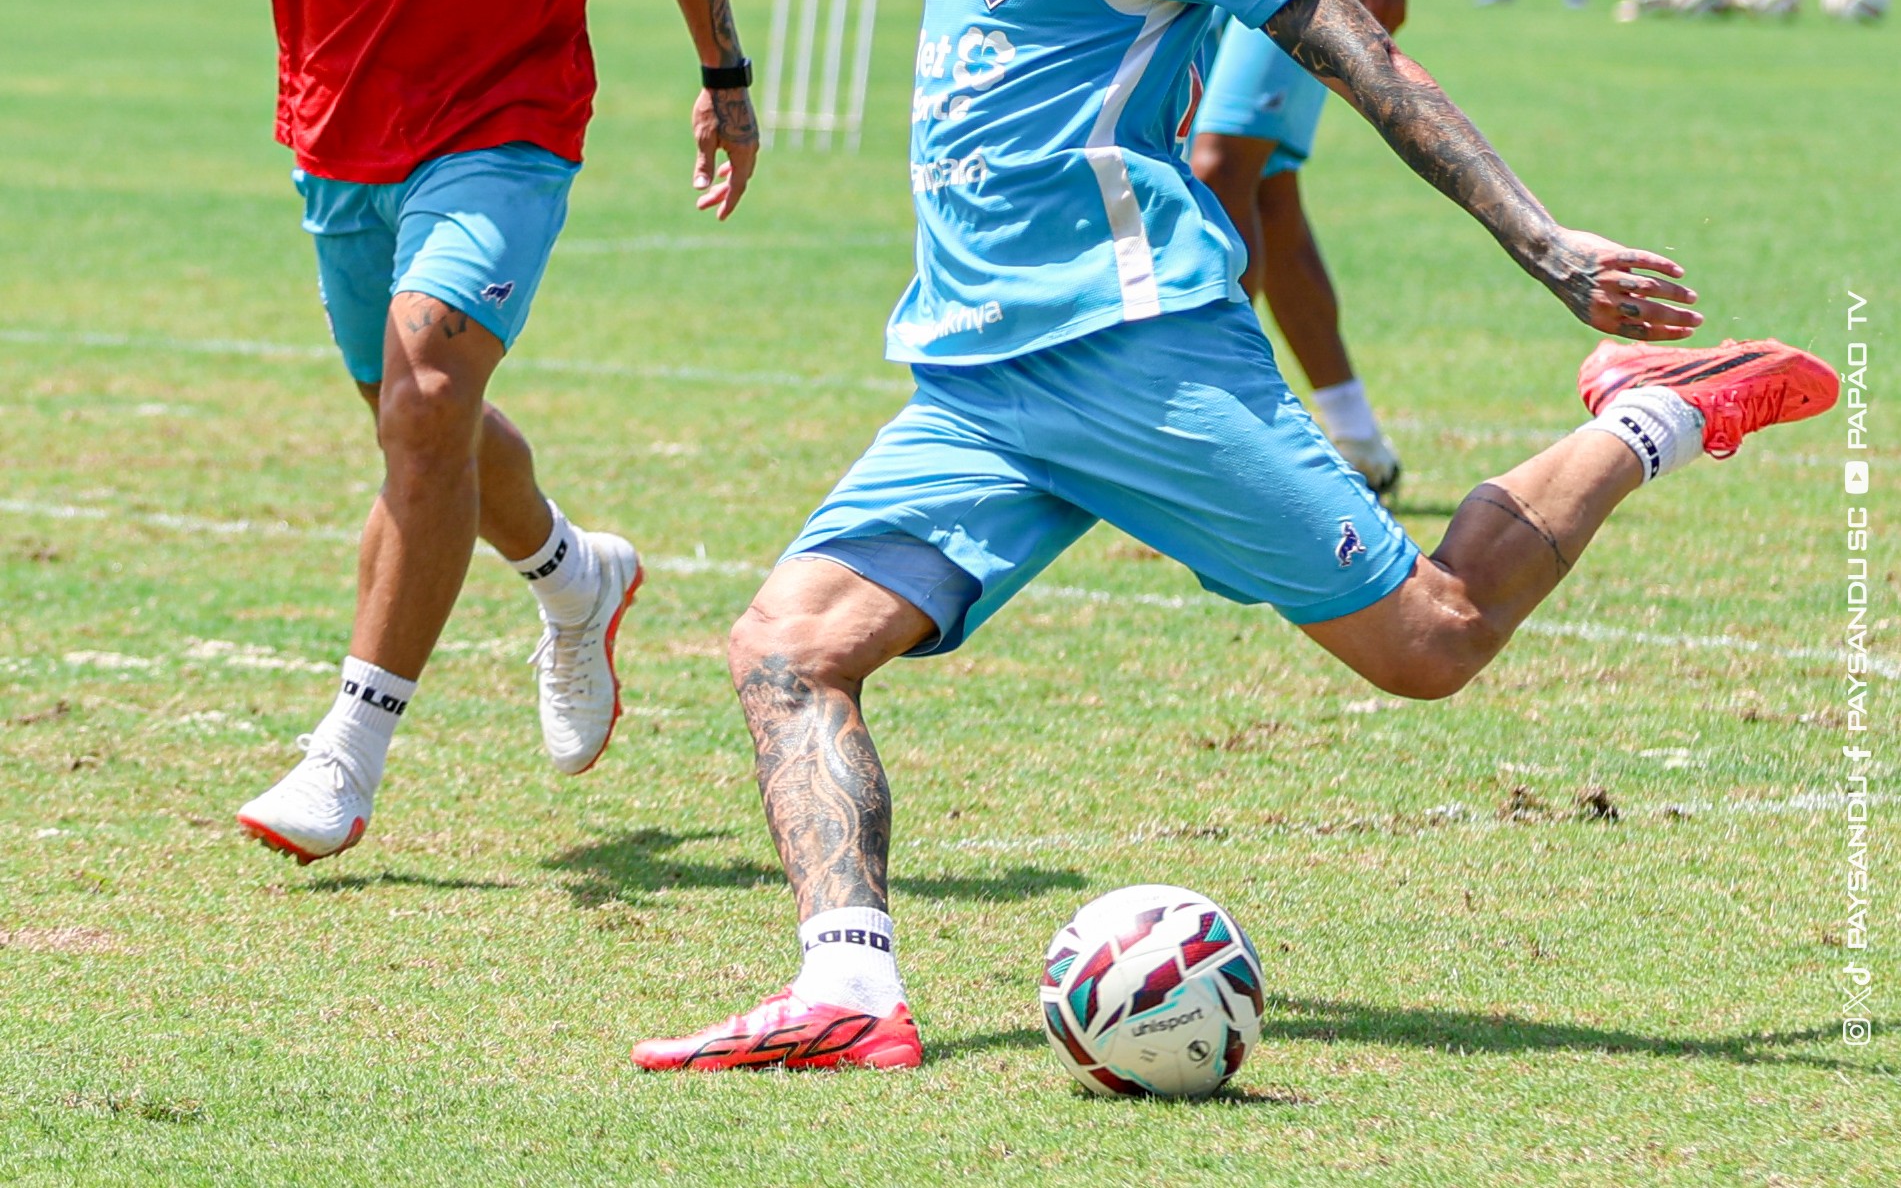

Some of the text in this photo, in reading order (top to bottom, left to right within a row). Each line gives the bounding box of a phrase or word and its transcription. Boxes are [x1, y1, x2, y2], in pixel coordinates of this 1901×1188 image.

[915, 28, 952, 79] et
[805, 928, 890, 952] LOBO
[1131, 1008, 1204, 1037] uhlsport
